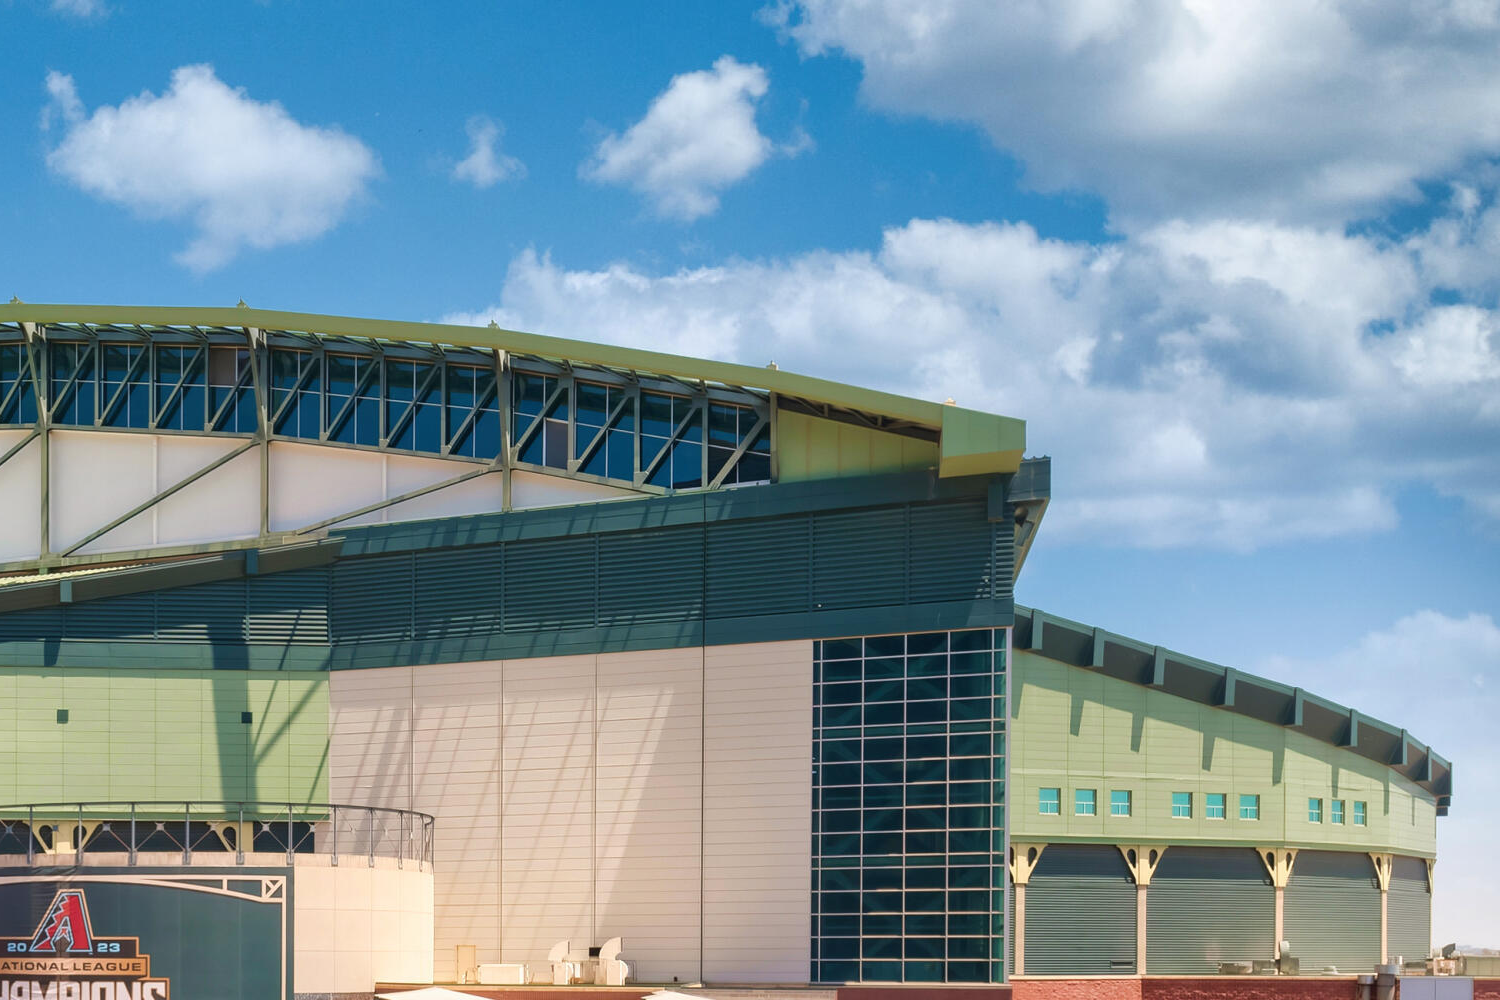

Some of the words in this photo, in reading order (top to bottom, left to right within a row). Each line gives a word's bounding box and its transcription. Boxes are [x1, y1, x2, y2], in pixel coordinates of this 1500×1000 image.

[7, 942, 27, 952] 20
[97, 942, 121, 953] 23
[73, 961, 142, 972] LEAGUE
